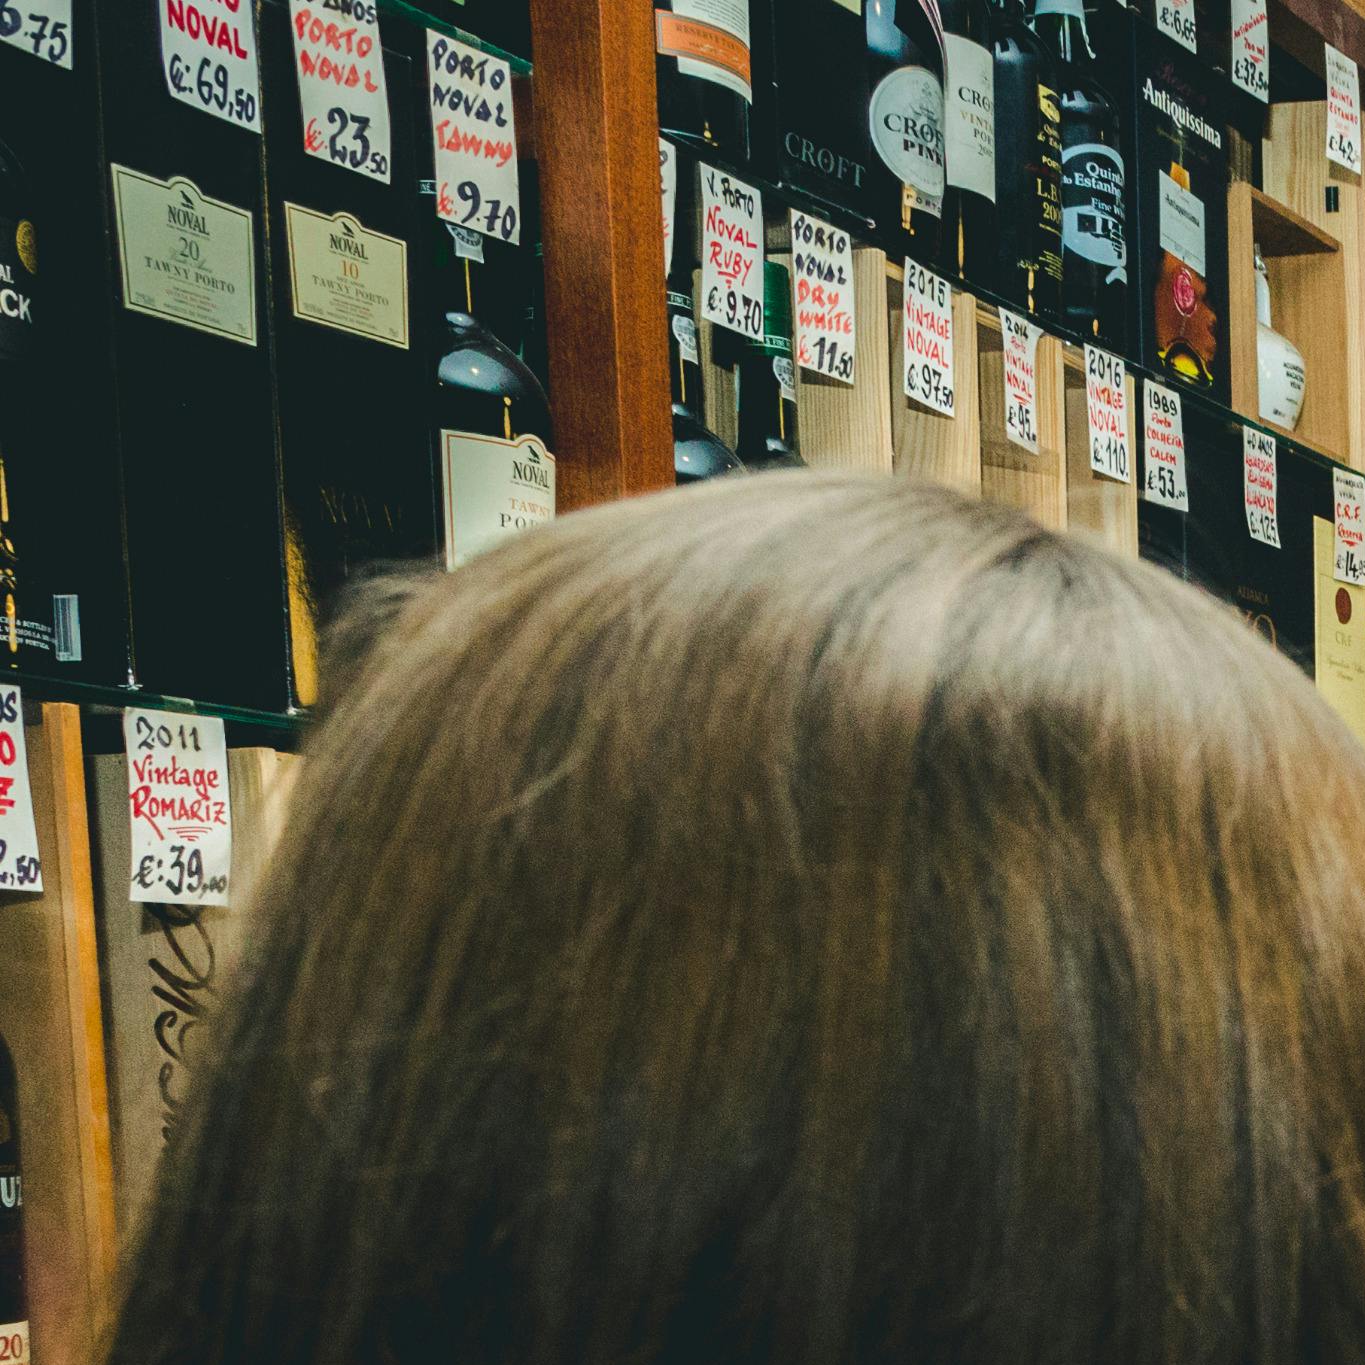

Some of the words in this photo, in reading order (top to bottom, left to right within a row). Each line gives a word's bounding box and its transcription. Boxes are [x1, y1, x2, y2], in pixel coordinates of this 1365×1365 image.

[167, 2, 248, 60] NOVAL
[296, 12, 374, 58] PORTO
[433, 39, 506, 92] PORTO
[437, 122, 512, 166] TAWNY
[180, 238, 201, 259] 20
[710, 242, 753, 282] RUBY
[798, 277, 840, 310] DRY
[1149, 388, 1179, 418] 1989
[136, 716, 202, 751] 2011
[133, 755, 219, 800] Vintage
